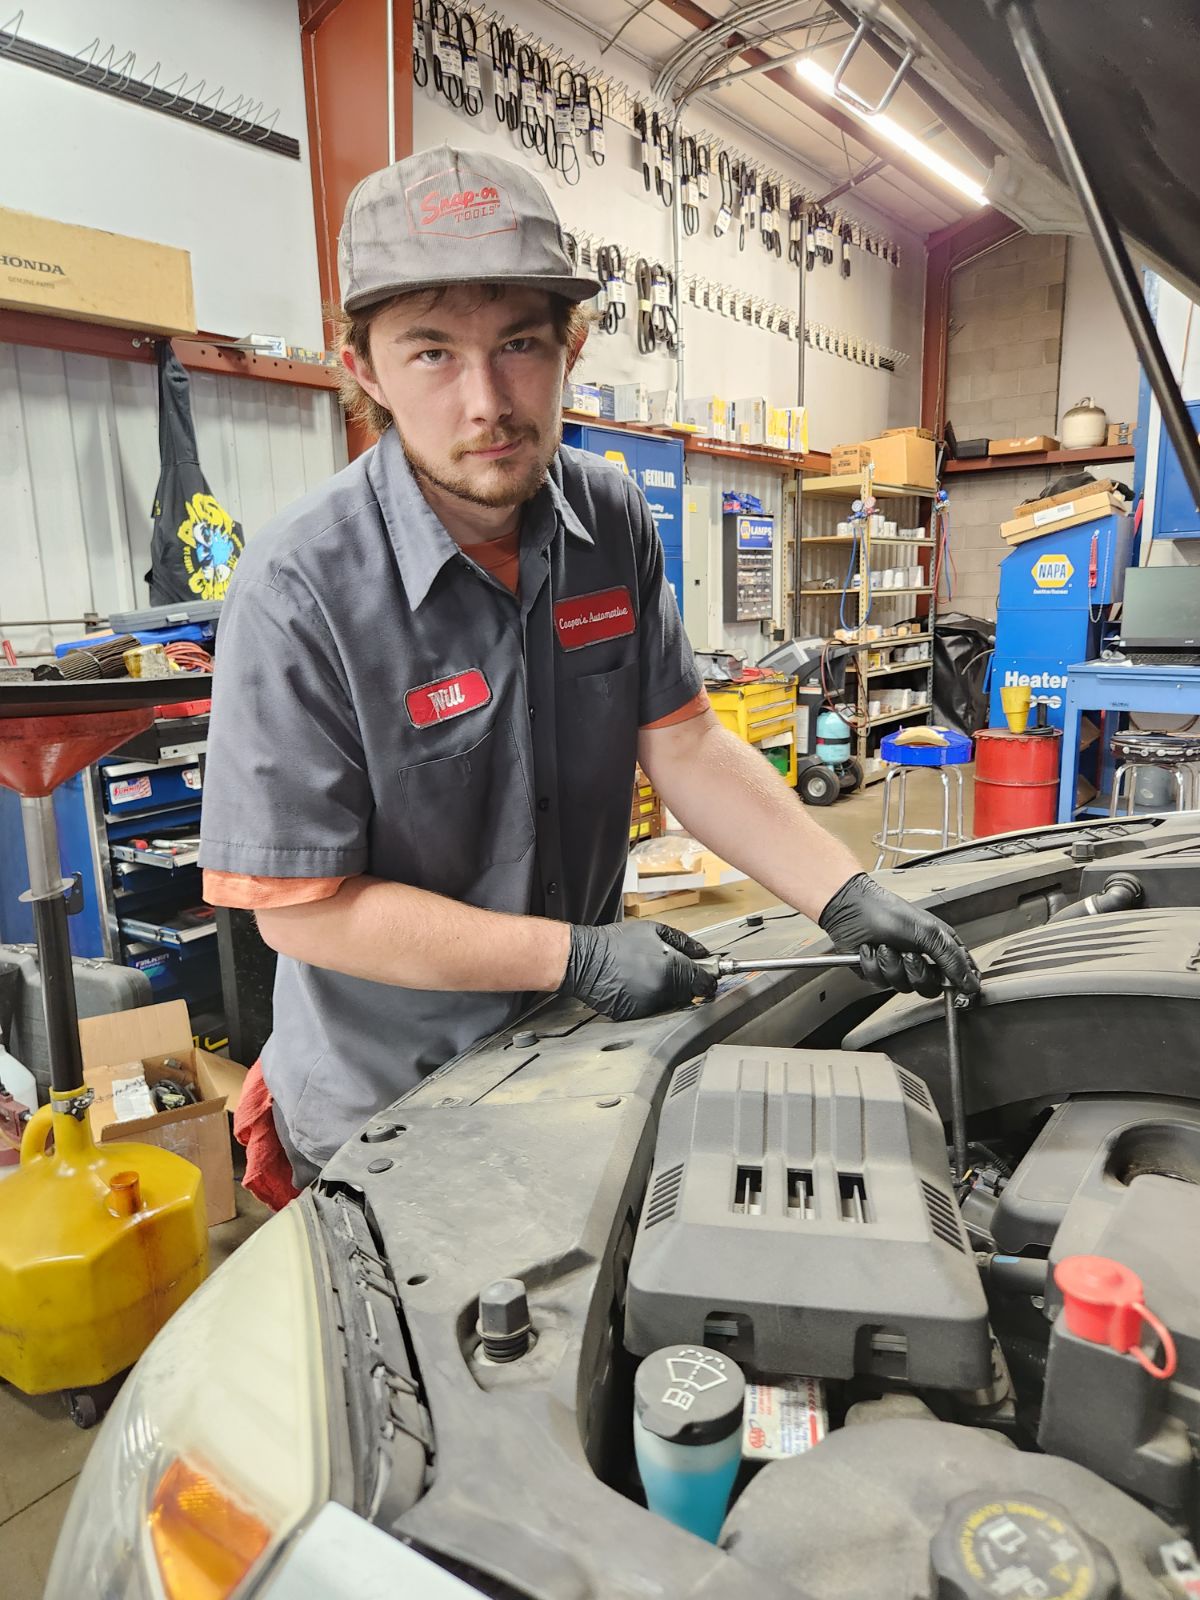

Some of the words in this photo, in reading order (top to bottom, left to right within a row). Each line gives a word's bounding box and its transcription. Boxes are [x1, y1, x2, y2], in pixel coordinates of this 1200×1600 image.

[420, 186, 499, 225] Snap-on
[0, 256, 66, 276] HONDA
[1038, 563, 1066, 579] NAPA
[559, 613, 589, 630] Cooper's
[589, 606, 629, 623] Automotive
[1005, 671, 1068, 689] Heater
[427, 683, 466, 712] Will
